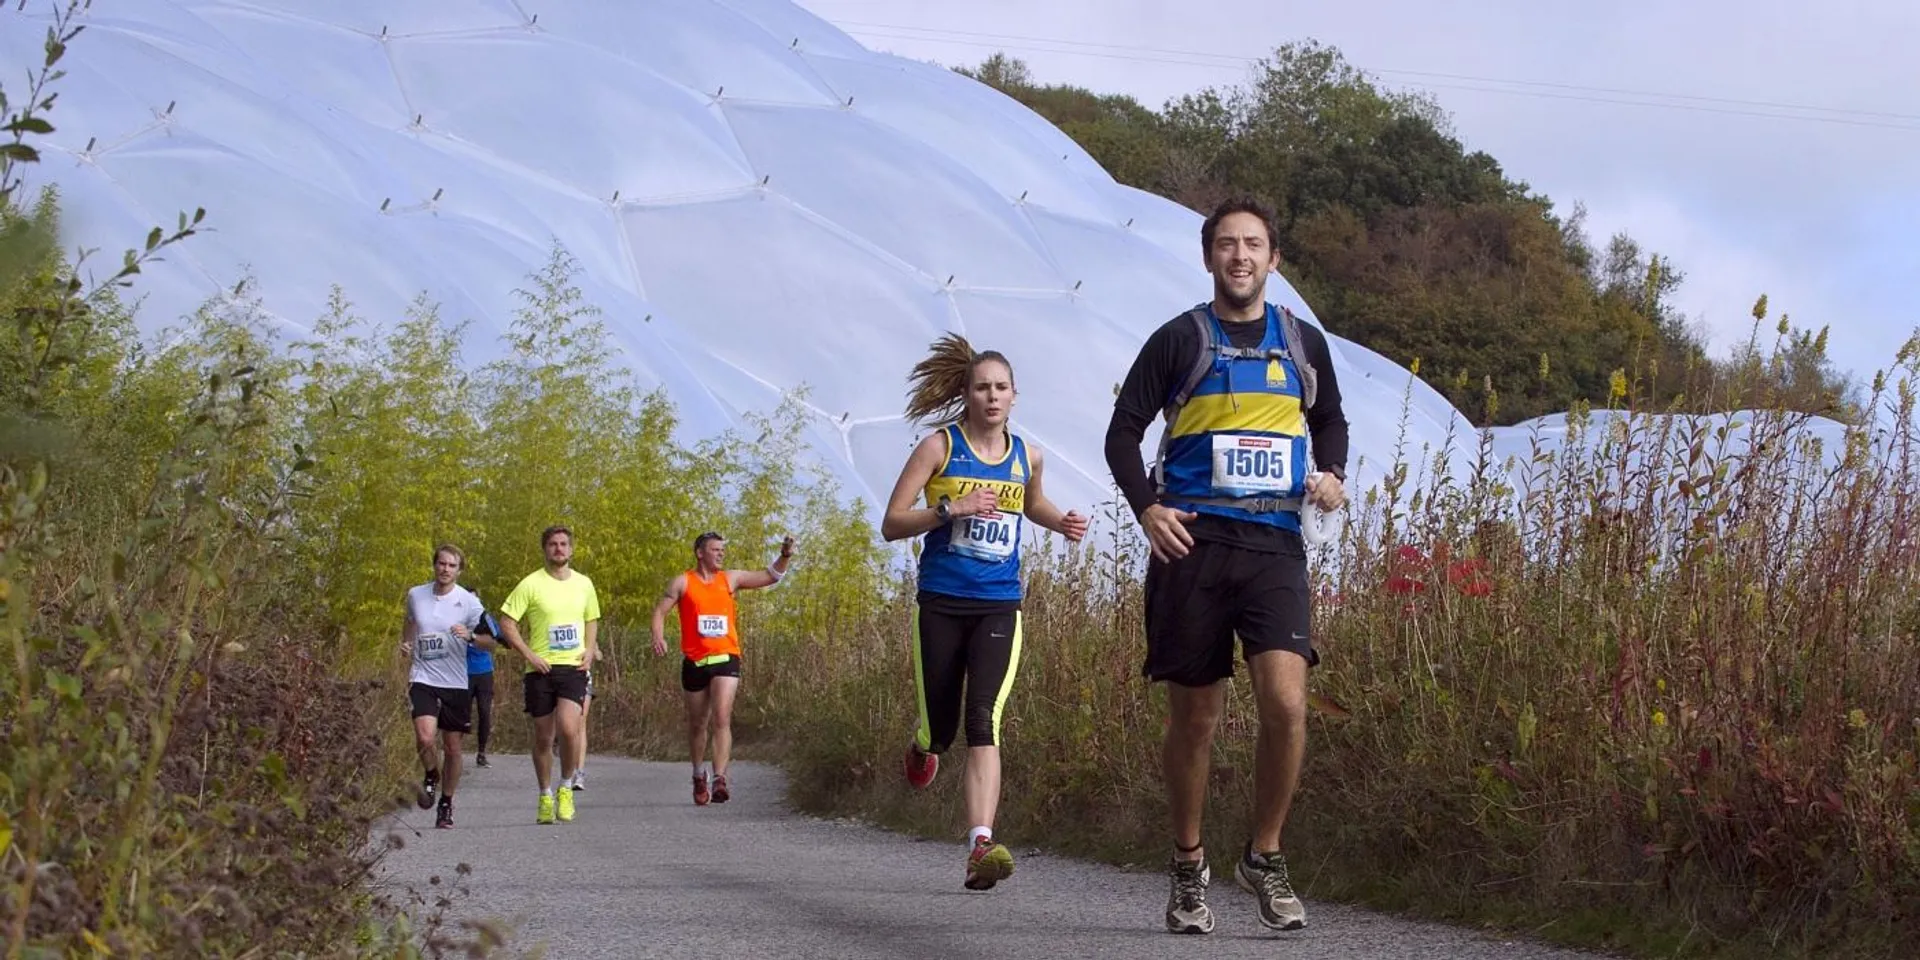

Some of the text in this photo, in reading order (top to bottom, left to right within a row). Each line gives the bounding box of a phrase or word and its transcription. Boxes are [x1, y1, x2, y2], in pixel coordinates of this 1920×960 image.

[1224, 448, 1284, 479] 1505
[963, 517, 1010, 547] 1504
[554, 628, 577, 641] 1301
[703, 619, 723, 630] 1734
